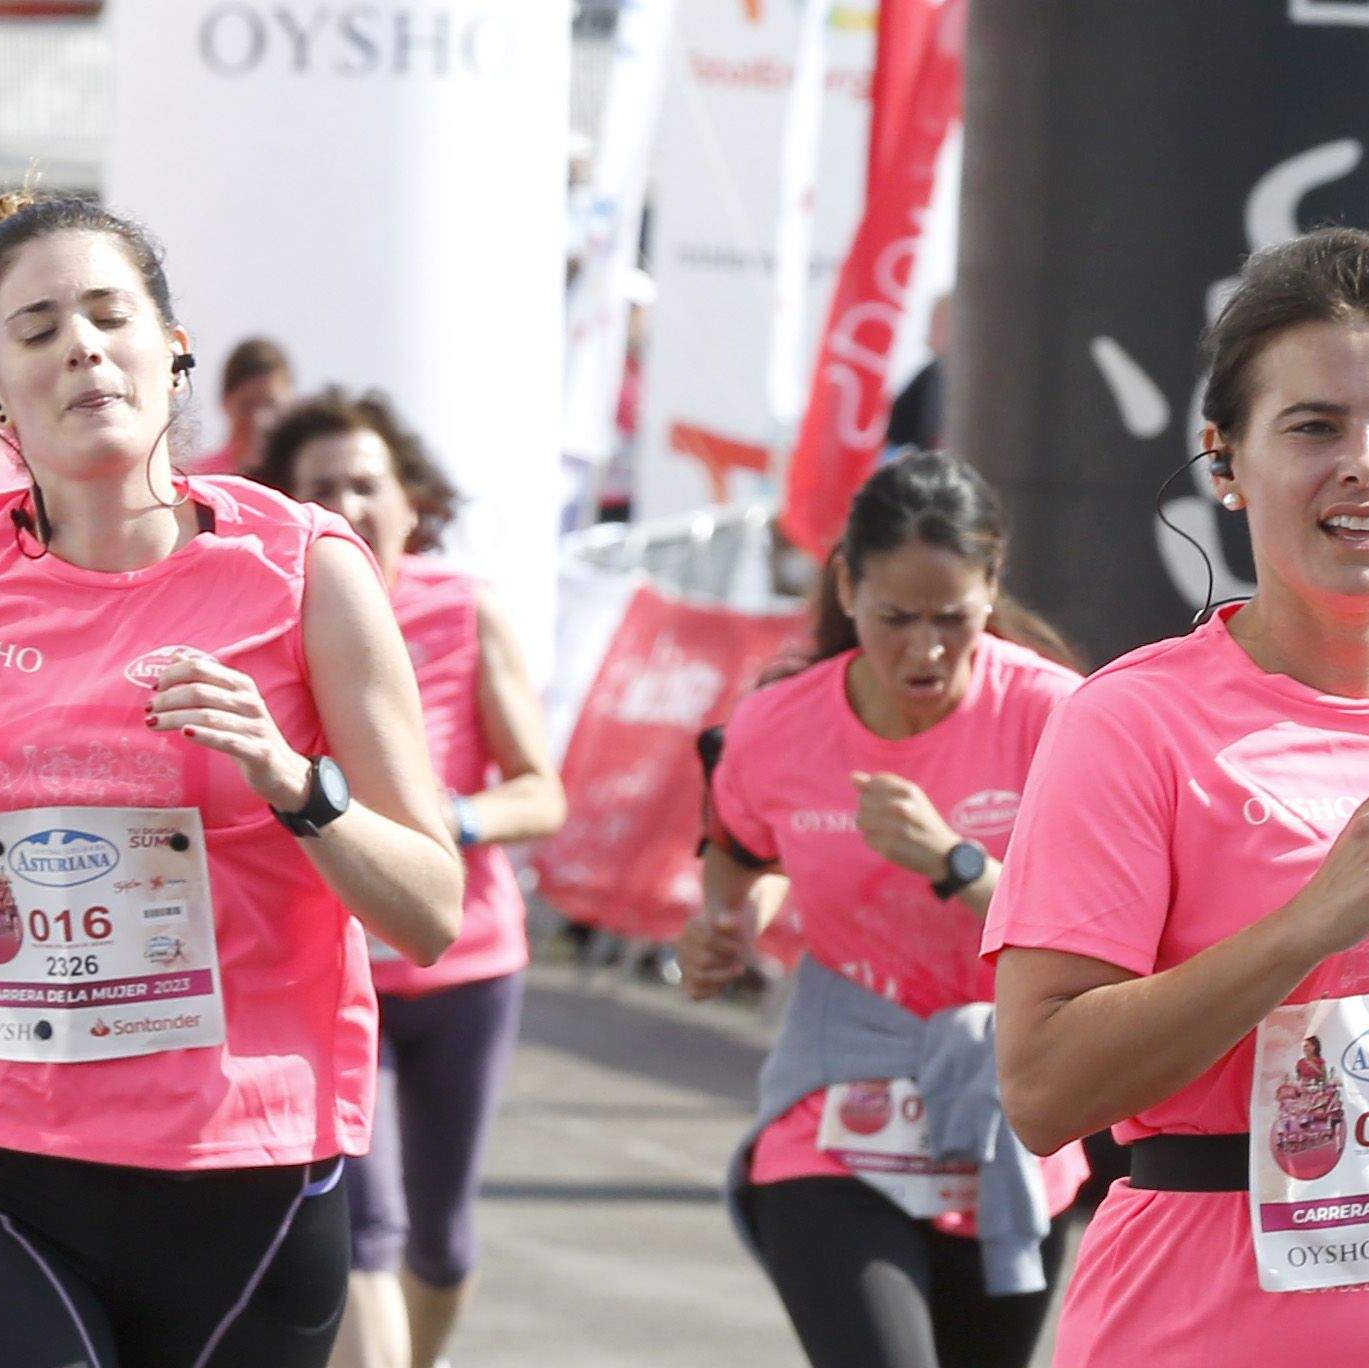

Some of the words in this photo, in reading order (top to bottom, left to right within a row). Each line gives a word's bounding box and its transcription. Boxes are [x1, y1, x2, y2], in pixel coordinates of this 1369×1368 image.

[17, 850, 110, 872] ASTURIANA
[29, 906, 112, 942] 016
[45, 955, 99, 976] 2326
[46, 989, 66, 1002] DE
[67, 990, 88, 1002] LA
[91, 983, 148, 1001] MUJER
[152, 977, 192, 995] 2023
[113, 1013, 202, 1037] Santander
